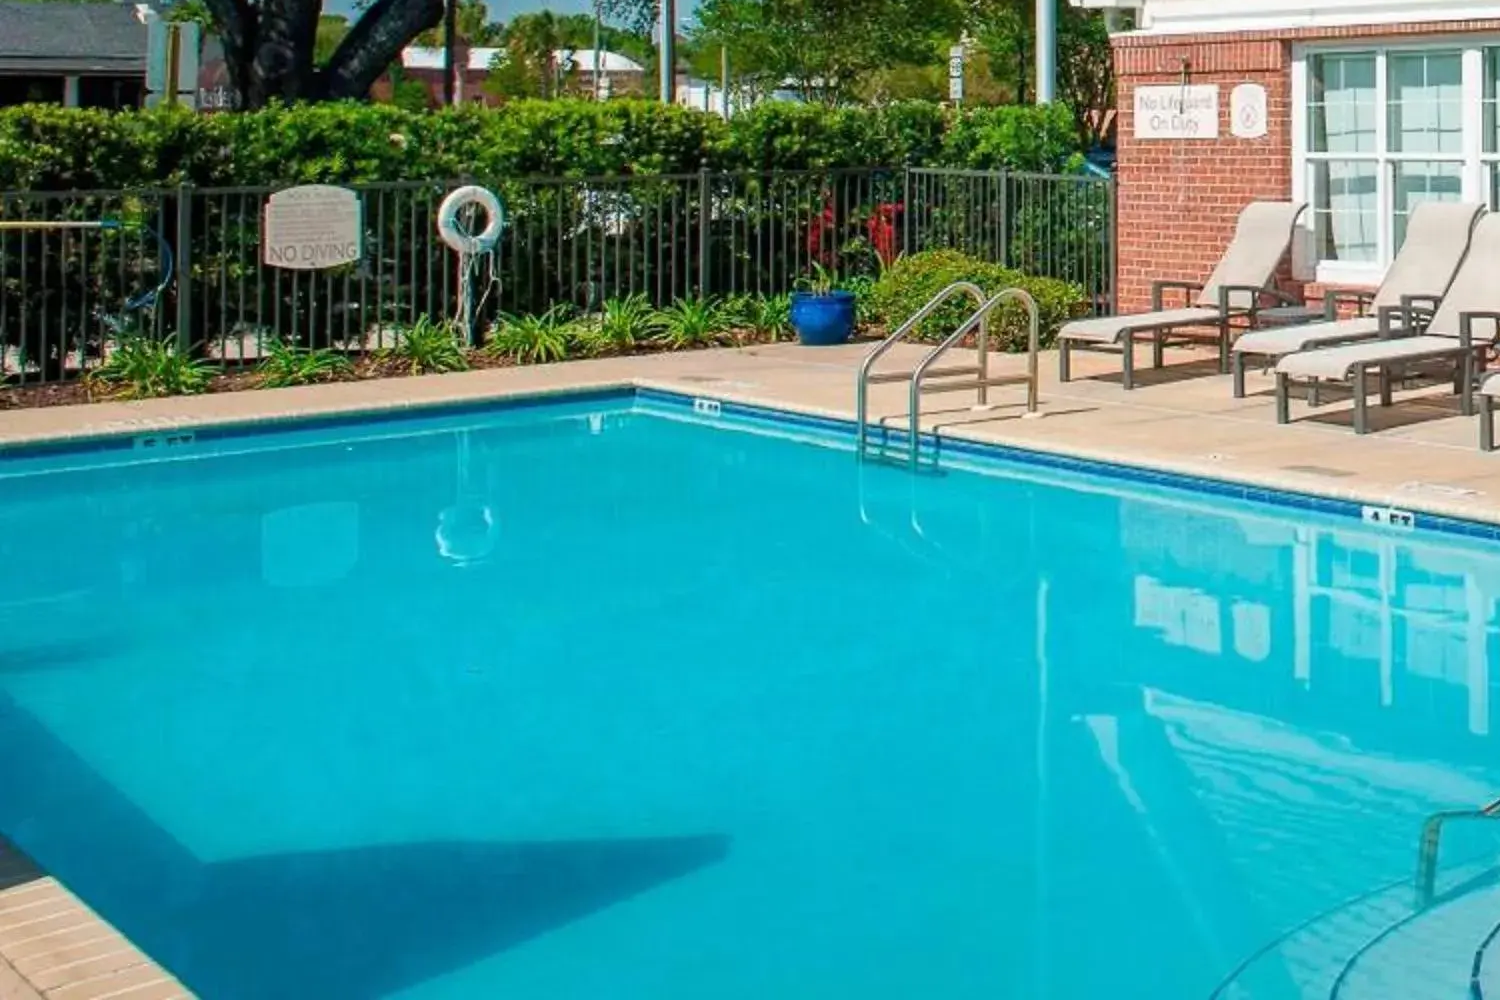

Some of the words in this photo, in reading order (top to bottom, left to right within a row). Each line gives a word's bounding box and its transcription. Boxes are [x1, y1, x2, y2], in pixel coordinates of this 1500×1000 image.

[1139, 94, 1157, 110] No
[1160, 92, 1213, 113] Lifeuard
[1149, 114, 1168, 131] On
[1171, 114, 1200, 135] Duty
[269, 245, 297, 263] NO
[301, 242, 357, 261] DIVING
[1389, 513, 1411, 526] FT
